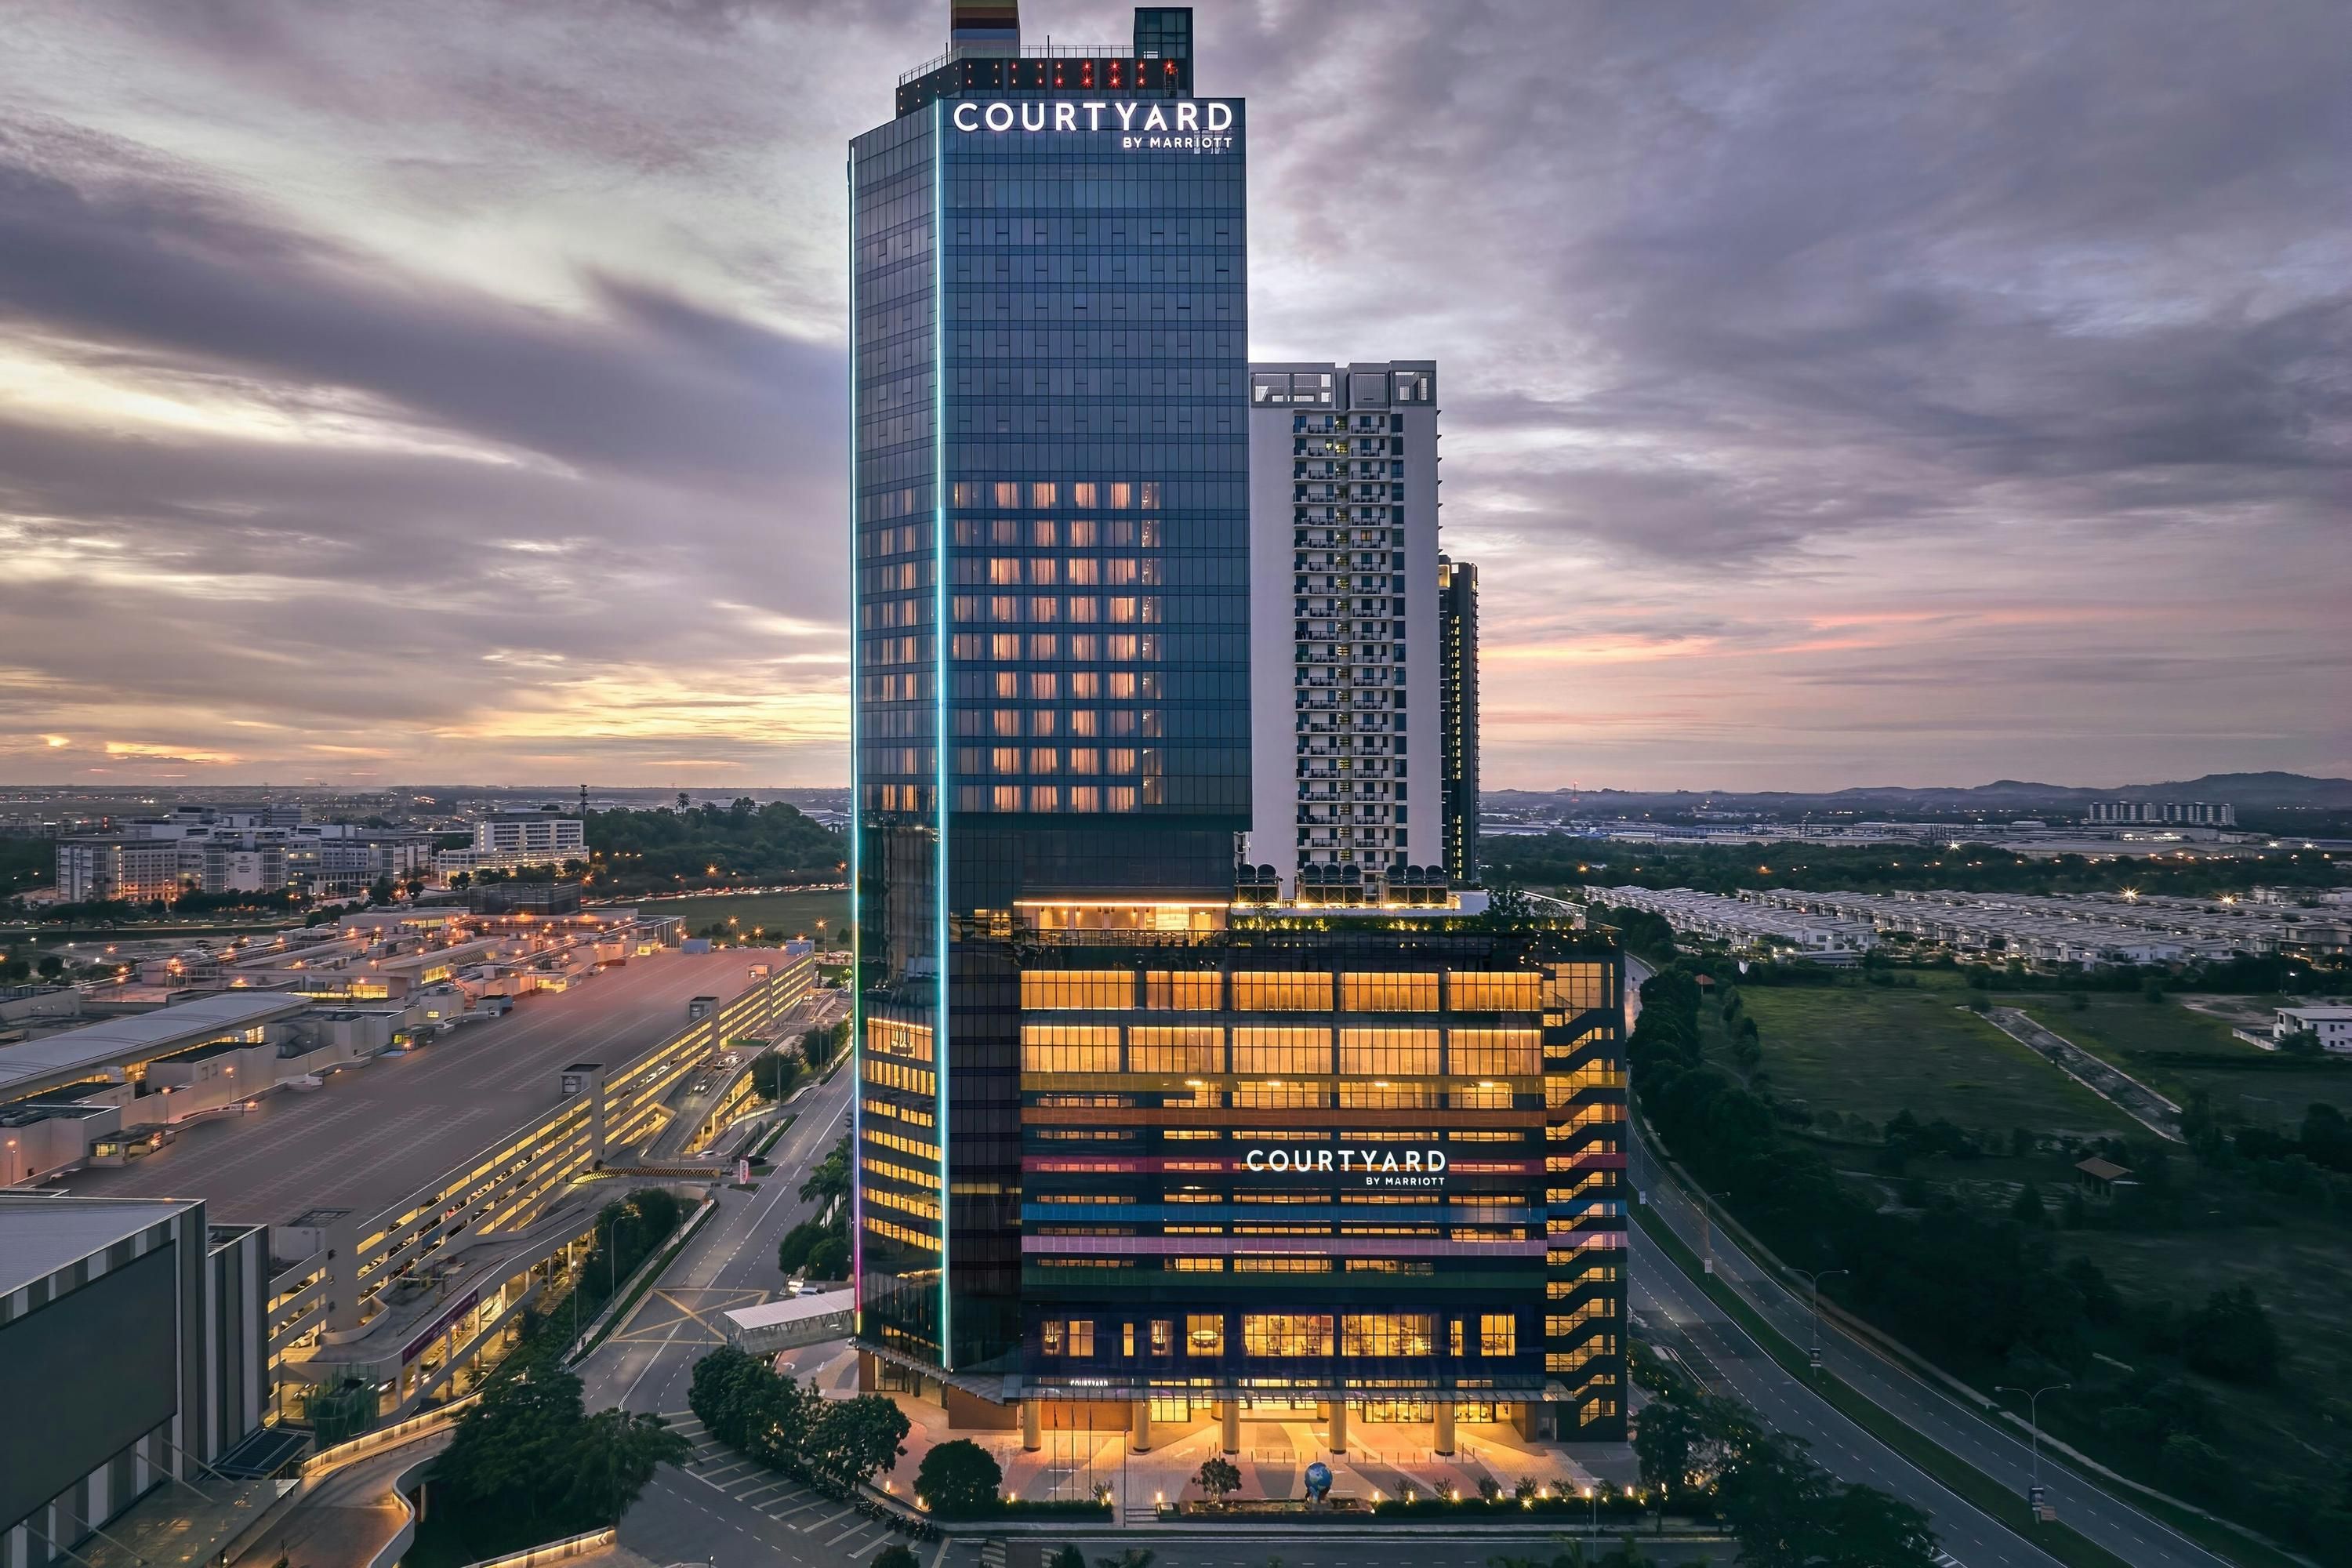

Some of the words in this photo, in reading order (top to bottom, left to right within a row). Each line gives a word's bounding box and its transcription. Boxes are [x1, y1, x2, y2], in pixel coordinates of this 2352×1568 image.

[953, 103, 1233, 132] COURTYARD
[1123, 137, 1142, 148] BY
[1149, 137, 1232, 148] MARRIOTT
[1247, 1149, 1446, 1172] COURTYARD
[1366, 1177, 1380, 1185] BY
[1385, 1177, 1445, 1185] MARRIOTT
